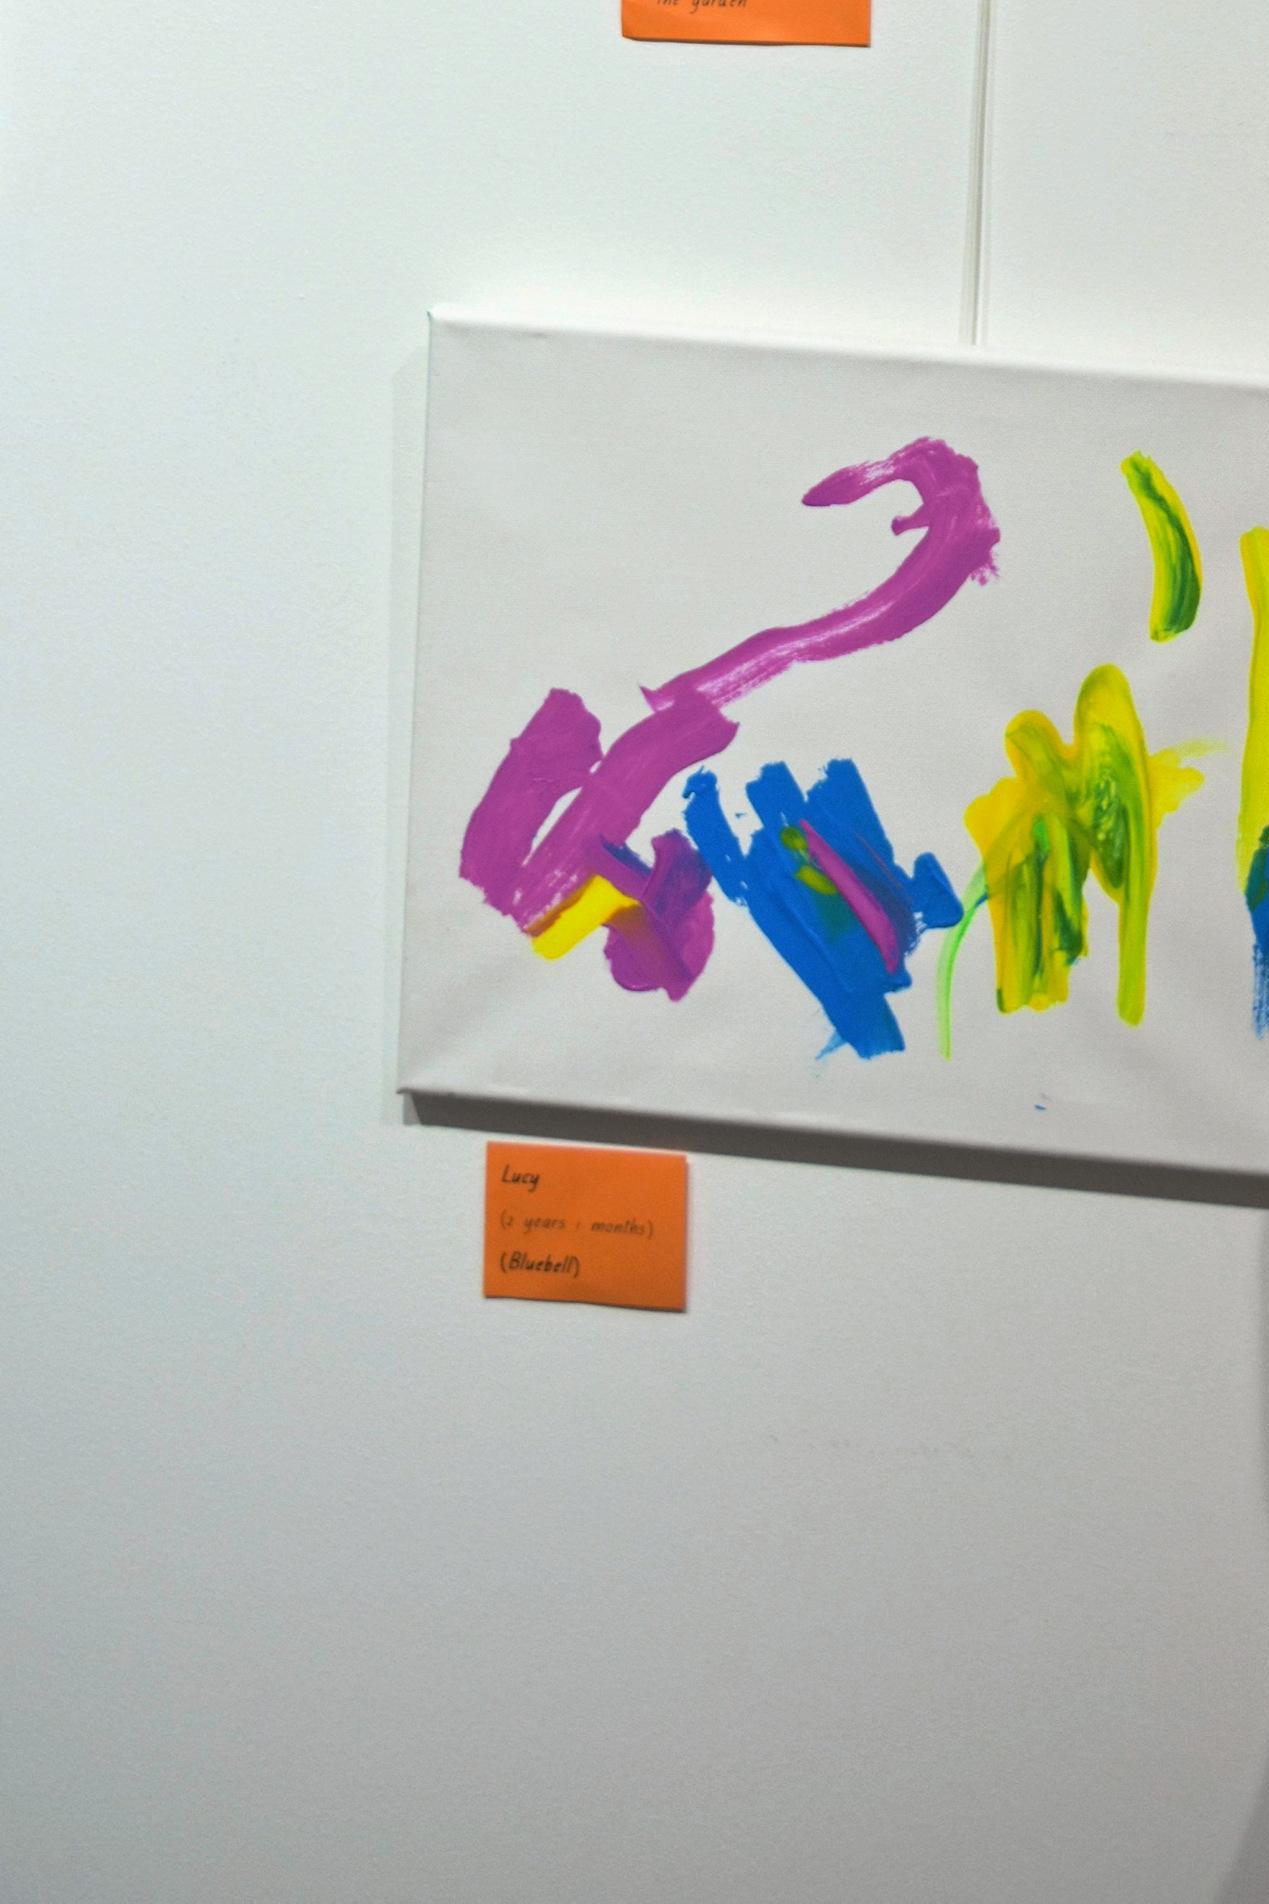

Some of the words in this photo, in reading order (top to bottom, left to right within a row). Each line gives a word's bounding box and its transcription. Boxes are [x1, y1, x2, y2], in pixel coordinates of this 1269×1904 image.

[501, 1163, 541, 1193] Lucy
[524, 1217, 566, 1233] years
[591, 1218, 654, 1239] months)
[500, 1251, 581, 1278] (Bluebell)
